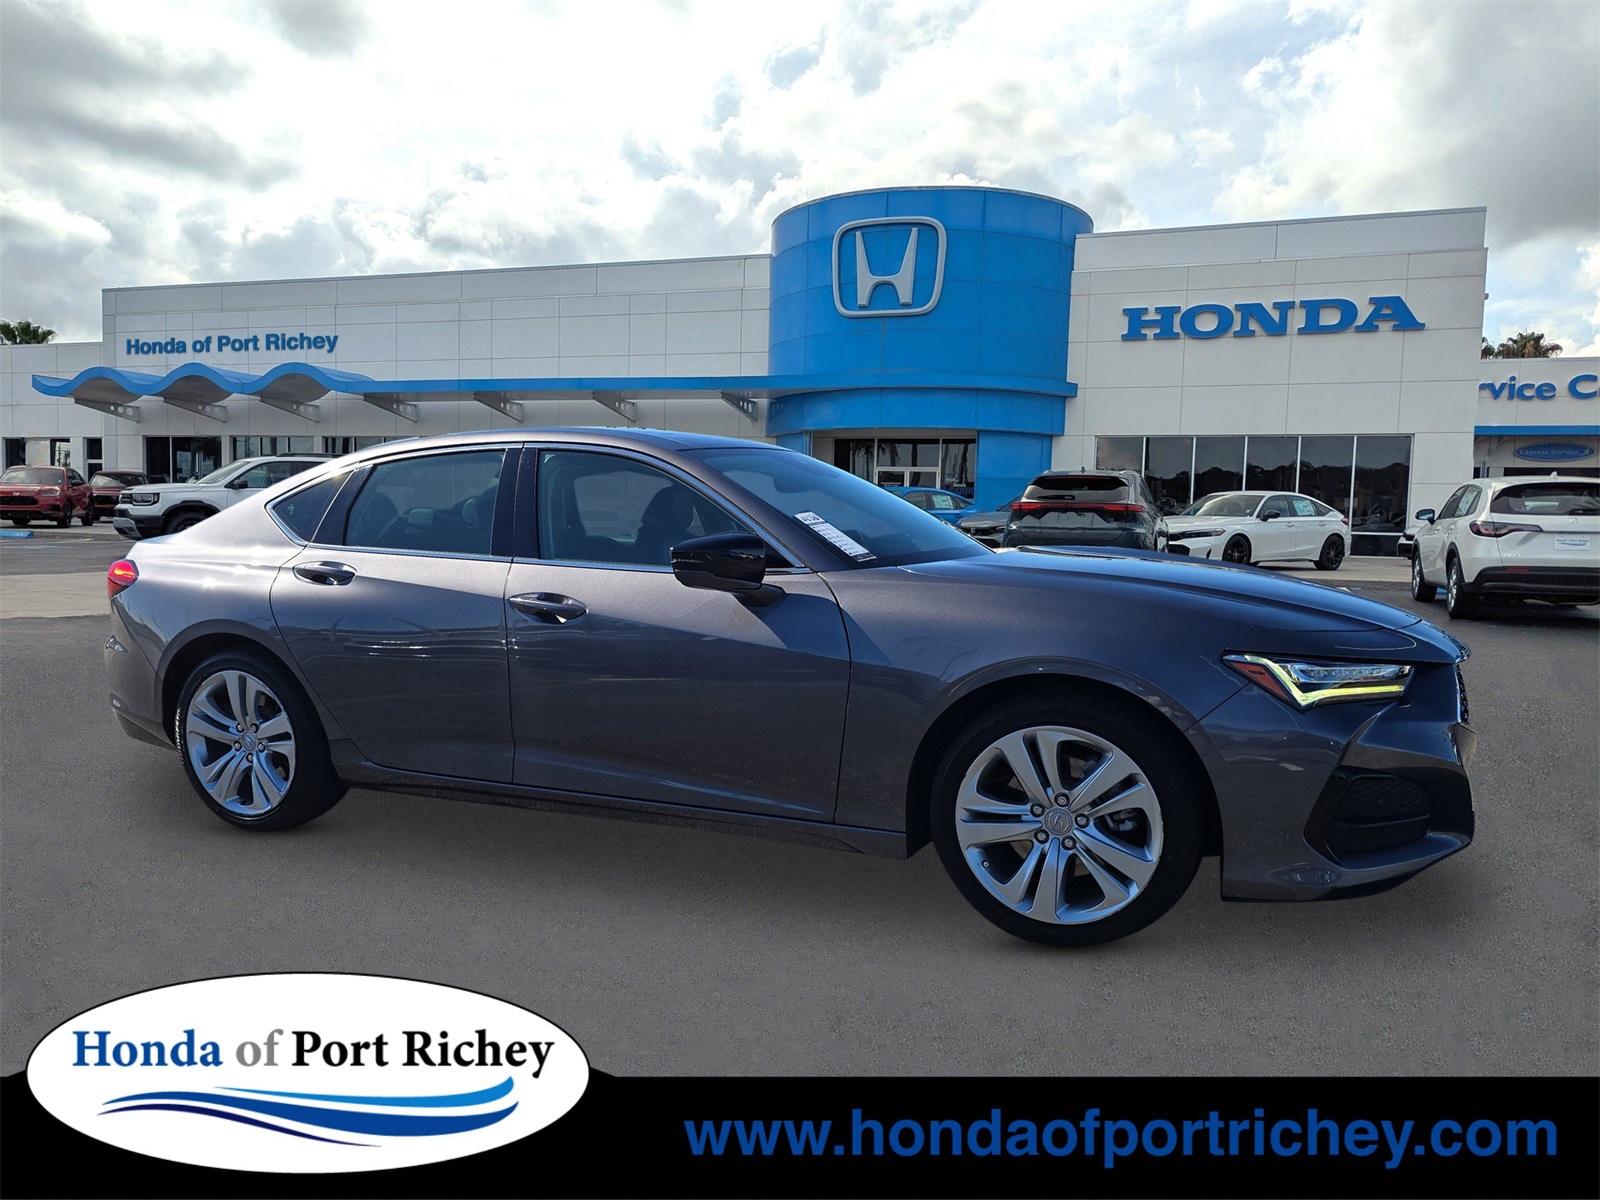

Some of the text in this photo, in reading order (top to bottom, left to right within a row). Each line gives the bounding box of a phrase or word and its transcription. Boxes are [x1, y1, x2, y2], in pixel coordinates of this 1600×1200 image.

[1121, 295, 1426, 341] HONDA
[126, 333, 339, 355] Honda of Port Richey
[1567, 373, 1600, 400] C
[1519, 447, 1579, 457] Express Service
